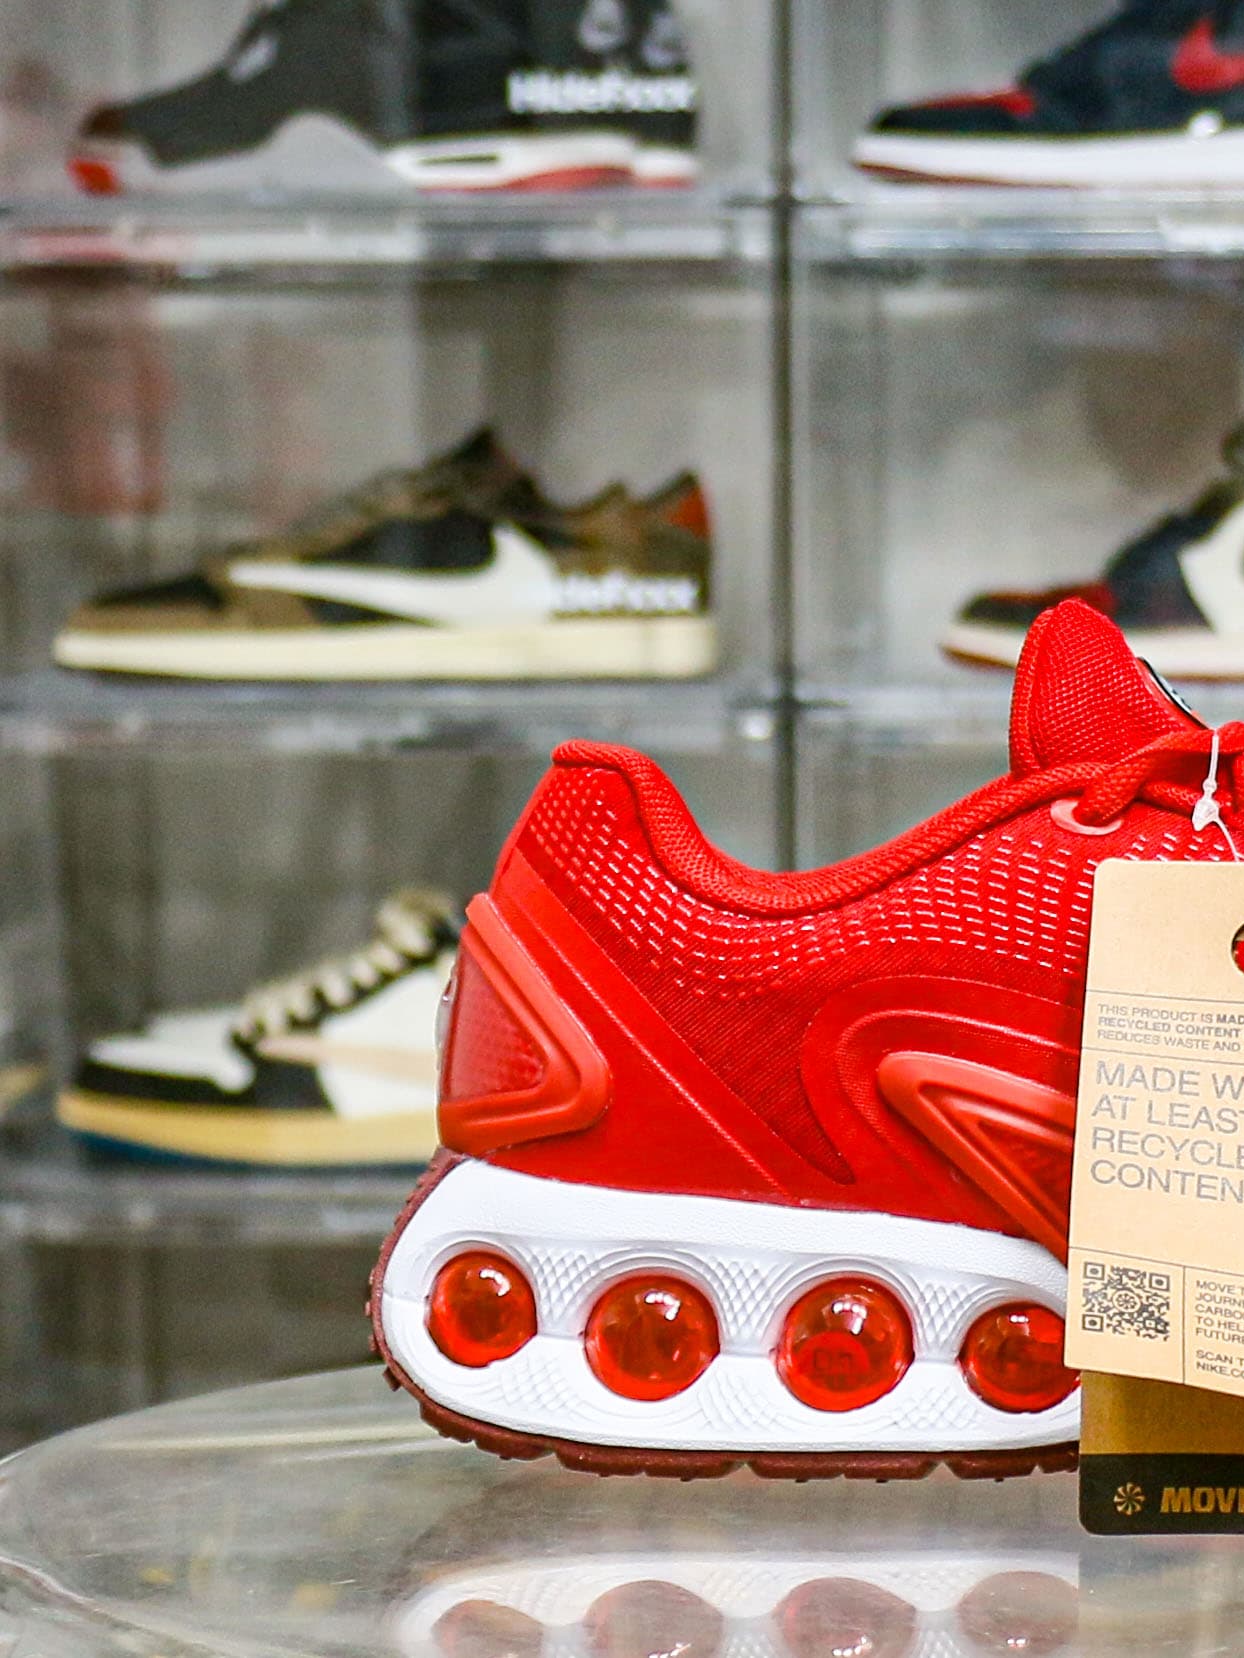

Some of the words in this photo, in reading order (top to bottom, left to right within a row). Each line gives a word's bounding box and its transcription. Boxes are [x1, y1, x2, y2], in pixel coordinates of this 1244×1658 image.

[1098, 1003, 1128, 1015] THIS
[1132, 1007, 1197, 1022] PRODUCT
[1201, 1013, 1213, 1023] IS
[1098, 1016, 1170, 1031] RECYCLED
[1175, 1024, 1241, 1038] CONTENT
[1097, 1029, 1160, 1044] REDUCES
[1164, 1037, 1210, 1050] WASTE
[1213, 1041, 1241, 1052] AND
[1096, 1061, 1200, 1096] MADE
[1091, 1094, 1136, 1121] AT
[1196, 1280, 1235, 1294] MOVE
[1195, 1315, 1214, 1327] TO
[1196, 1350, 1233, 1364] SCAN
